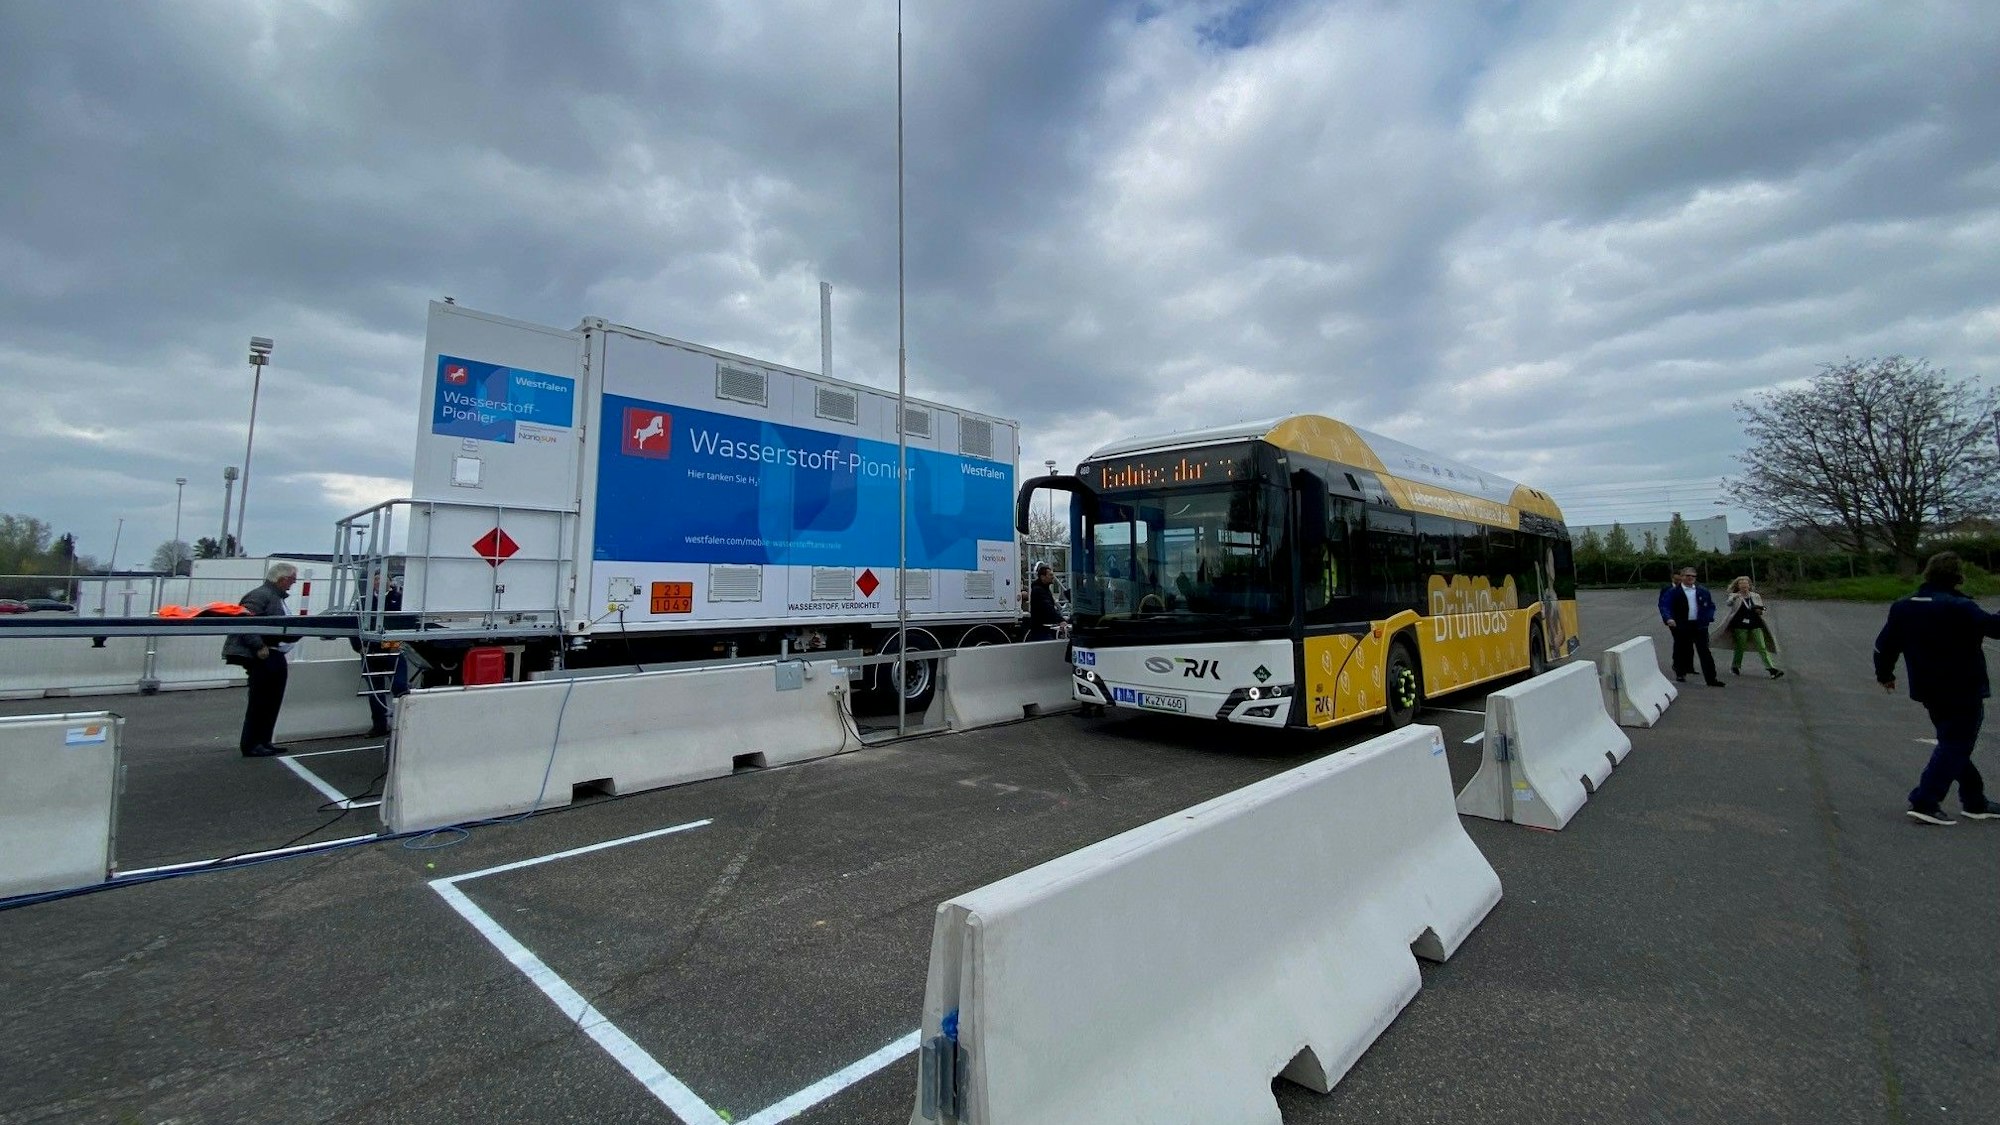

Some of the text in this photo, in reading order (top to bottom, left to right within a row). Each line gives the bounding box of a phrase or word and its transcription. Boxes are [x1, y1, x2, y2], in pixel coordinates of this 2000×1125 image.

[516, 377, 567, 392] Westfalen
[444, 391, 540, 414] Wasserstoff-
[442, 406, 496, 423] Pionier
[687, 469, 705, 479] Hier
[706, 471, 734, 483] tanken
[735, 474, 747, 484] Sie
[960, 463, 1005, 480] Westfalen
[664, 584, 681, 597] 23
[654, 599, 690, 612] 1049
[788, 601, 881, 611] WASSERSTOFF, VERDICHTET
[1433, 589, 1507, 642] BrühlGas
[1145, 695, 1182, 709] K ZY 460
